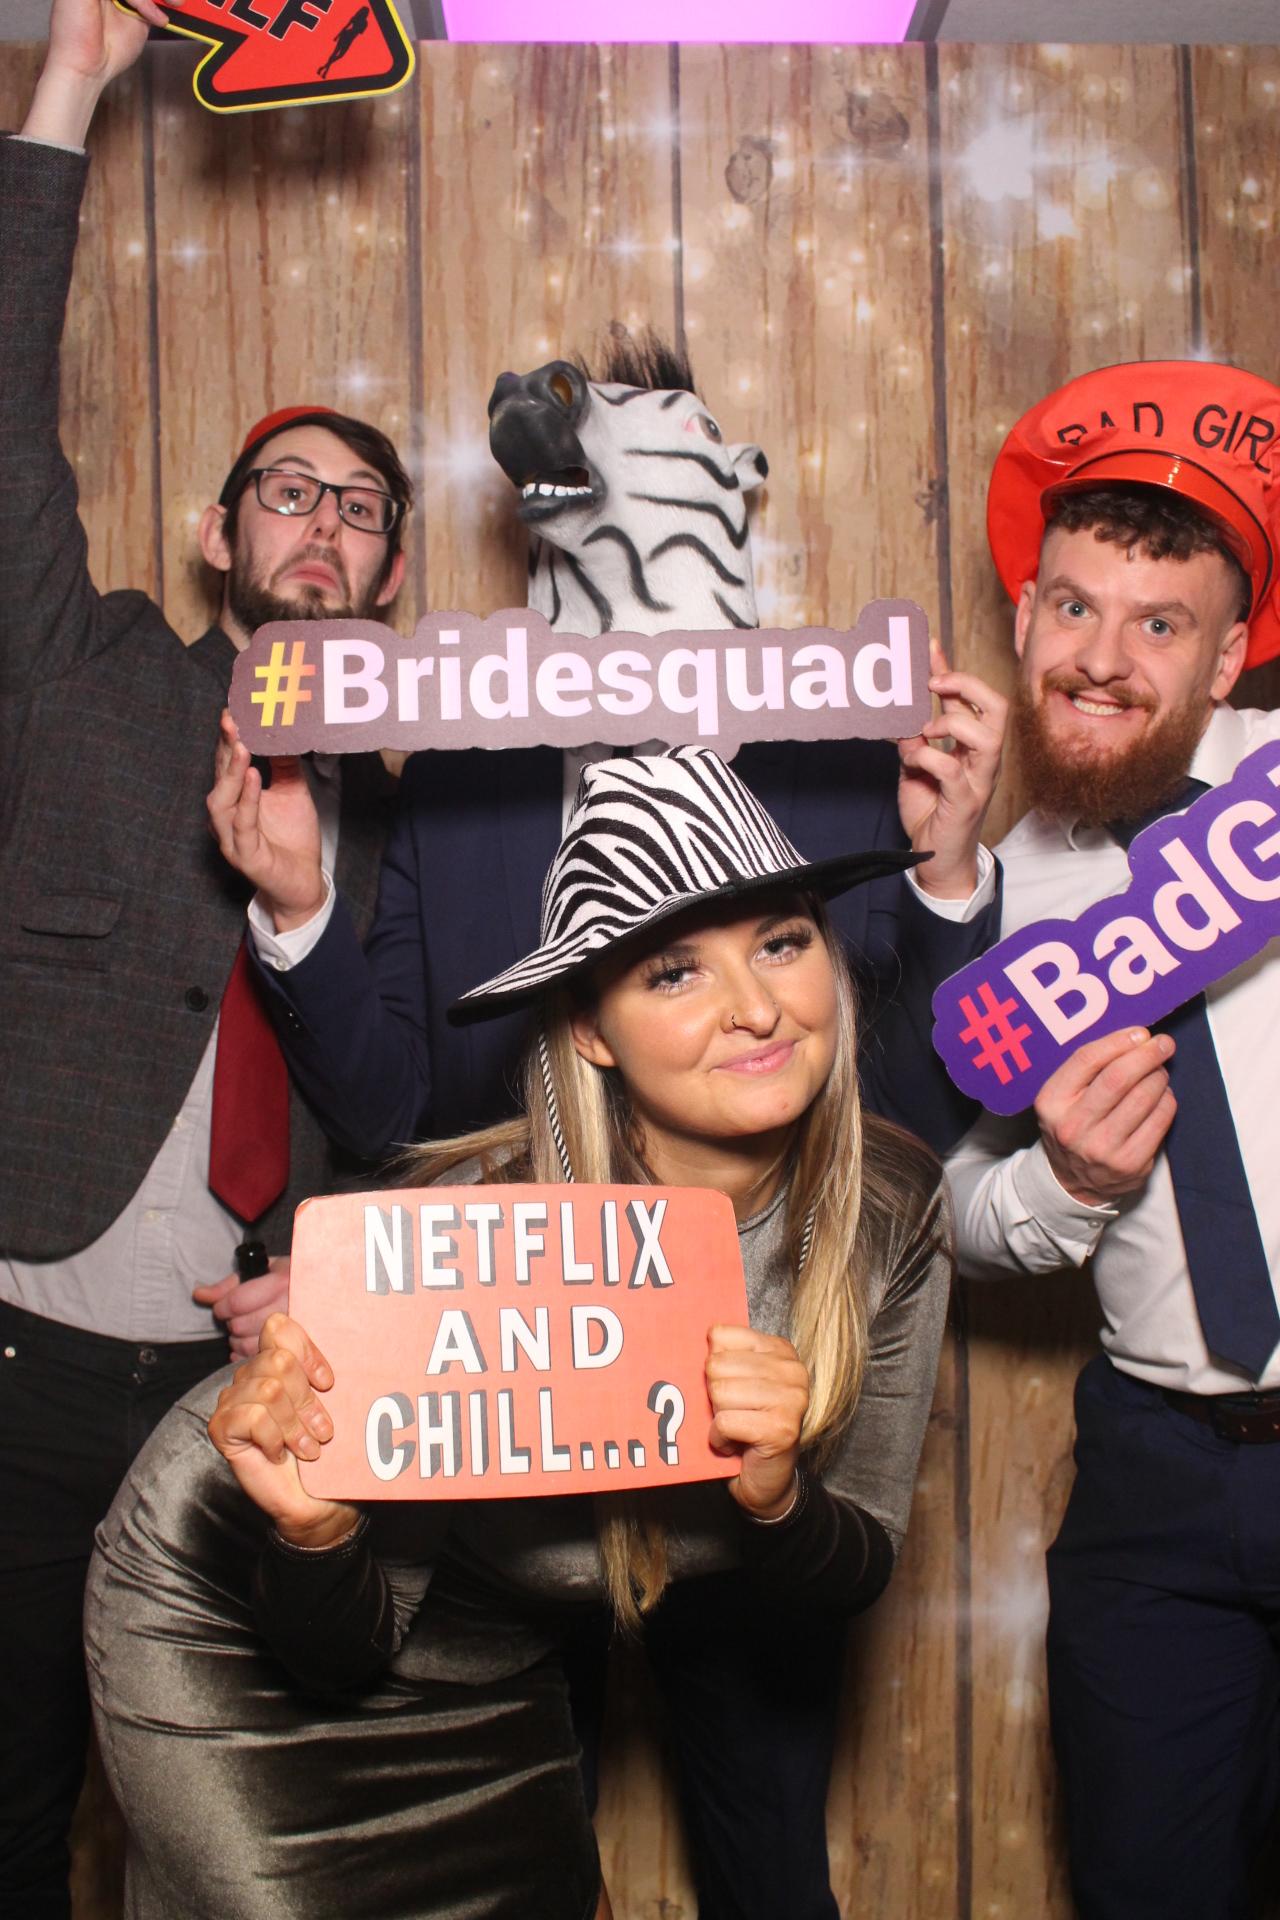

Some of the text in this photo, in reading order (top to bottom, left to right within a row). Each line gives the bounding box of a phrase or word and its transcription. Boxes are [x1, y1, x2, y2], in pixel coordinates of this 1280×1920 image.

[251, 615, 912, 736] #Bridesquad
[958, 765, 1280, 1085] #BadG
[364, 1199, 674, 1295] NETFLIX
[425, 1305, 625, 1375] AND
[365, 1381, 686, 1482] CHILL...?
